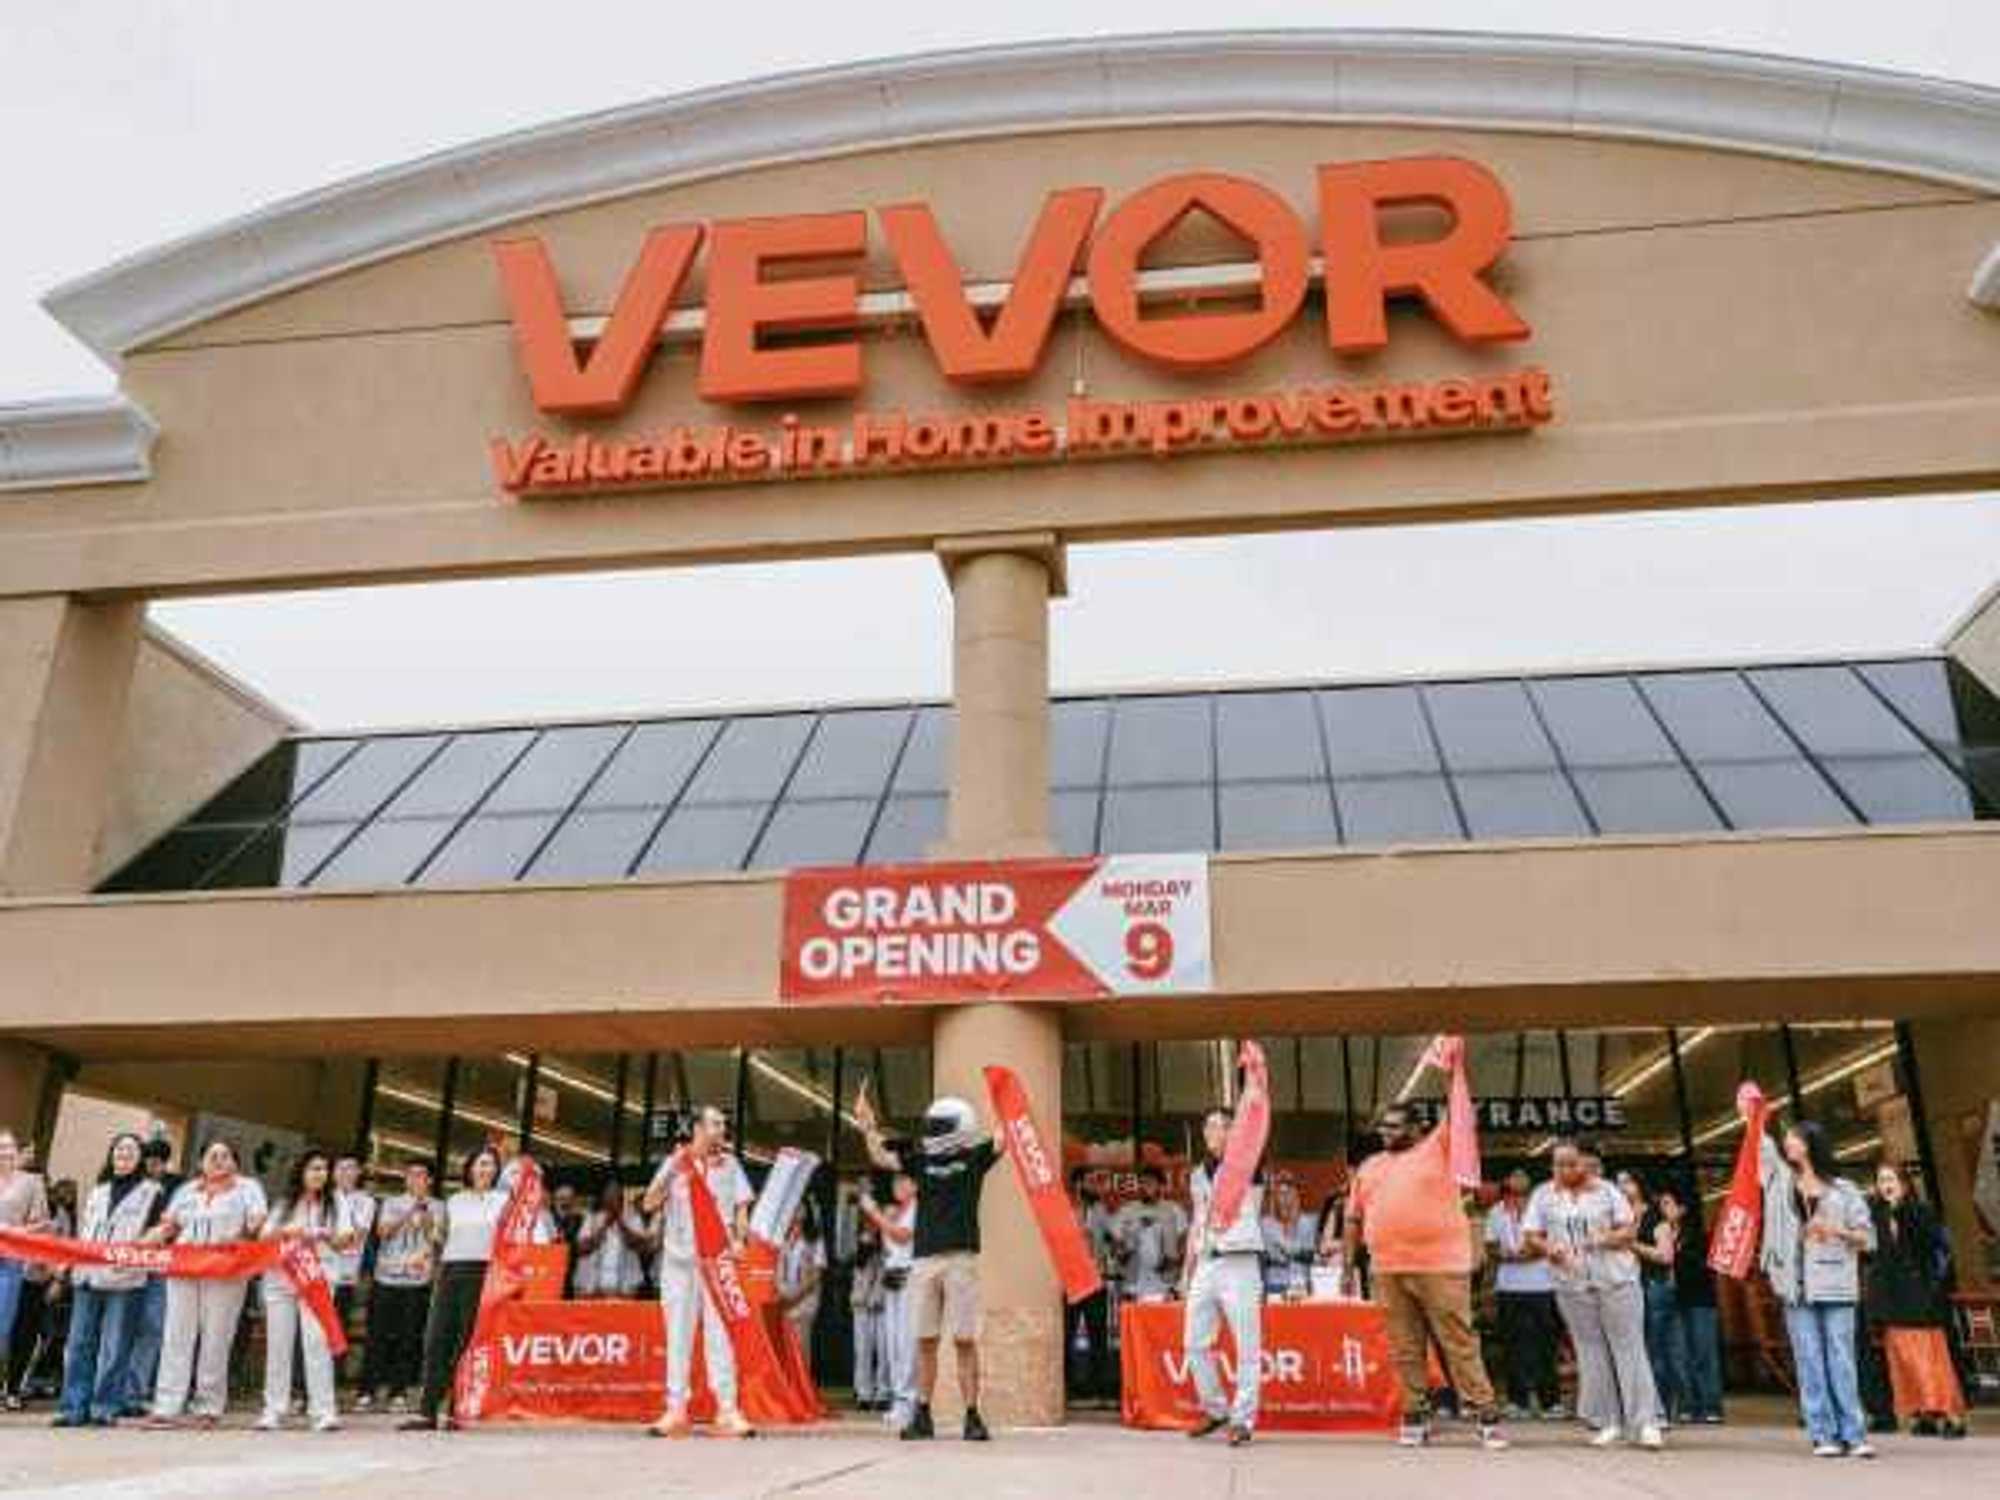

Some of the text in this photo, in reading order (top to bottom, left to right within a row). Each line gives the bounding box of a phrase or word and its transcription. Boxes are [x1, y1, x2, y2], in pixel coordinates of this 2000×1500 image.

[490, 152, 1530, 416] VEVOR
[487, 368, 1552, 490] Valuable in Home Improvement
[822, 882, 1017, 930] GRAND
[1102, 879, 1192, 898] MONDAY
[1123, 899, 1172, 917] MAR
[799, 928, 1042, 981] OPENING
[1125, 921, 1174, 980] 9
[503, 1332, 630, 1366] VEVOR
